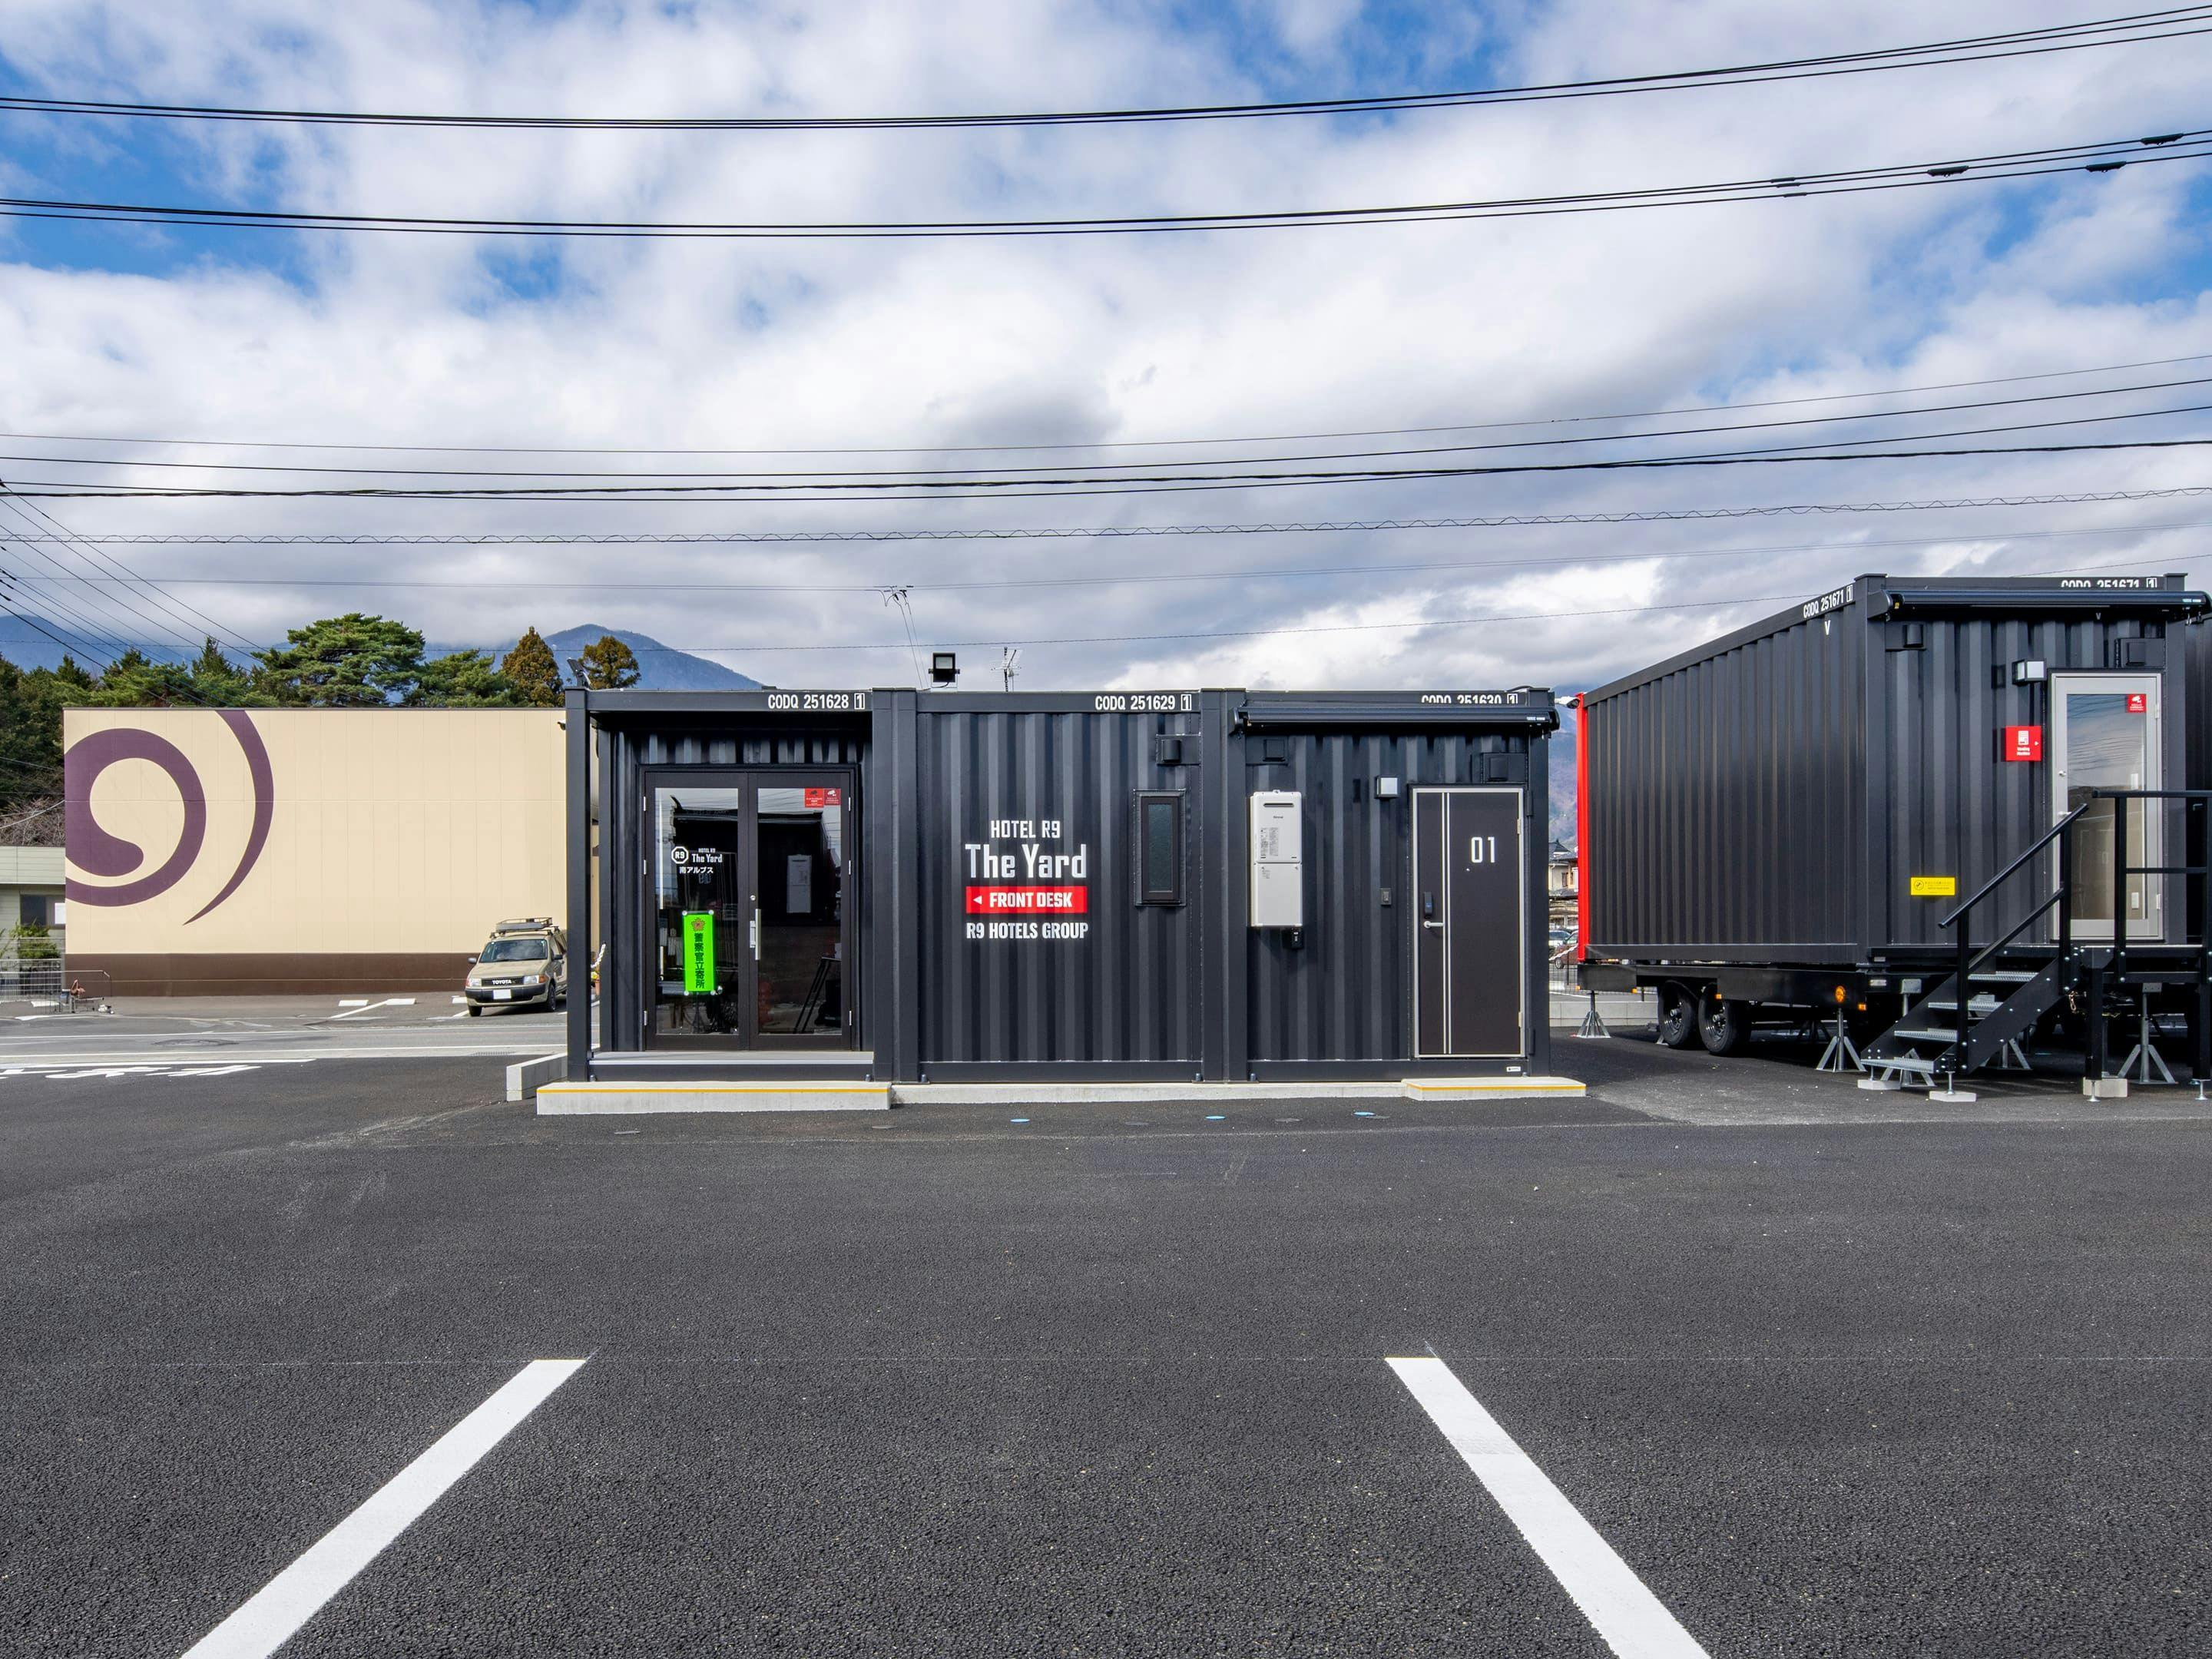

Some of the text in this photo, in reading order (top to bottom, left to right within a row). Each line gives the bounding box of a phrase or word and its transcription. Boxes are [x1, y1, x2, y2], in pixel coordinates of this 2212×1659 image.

[1803, 601, 1819, 618] CODQ
[1821, 590, 1843, 611] 251671
[1824, 620, 1831, 635] V
[768, 694, 864, 709] CODQ 251628 1
[1095, 695, 1190, 710] CODQ 251629 1
[991, 820, 1061, 838] HOTEL R9
[691, 853, 723, 863] The Yard
[1471, 836, 1495, 863] 01
[965, 843, 1087, 878] The Yard
[989, 892, 1073, 908] FRONT DESK
[966, 922, 1089, 939] R9 HOTELS GROUP
[694, 932, 705, 989] 警察官立寄所
